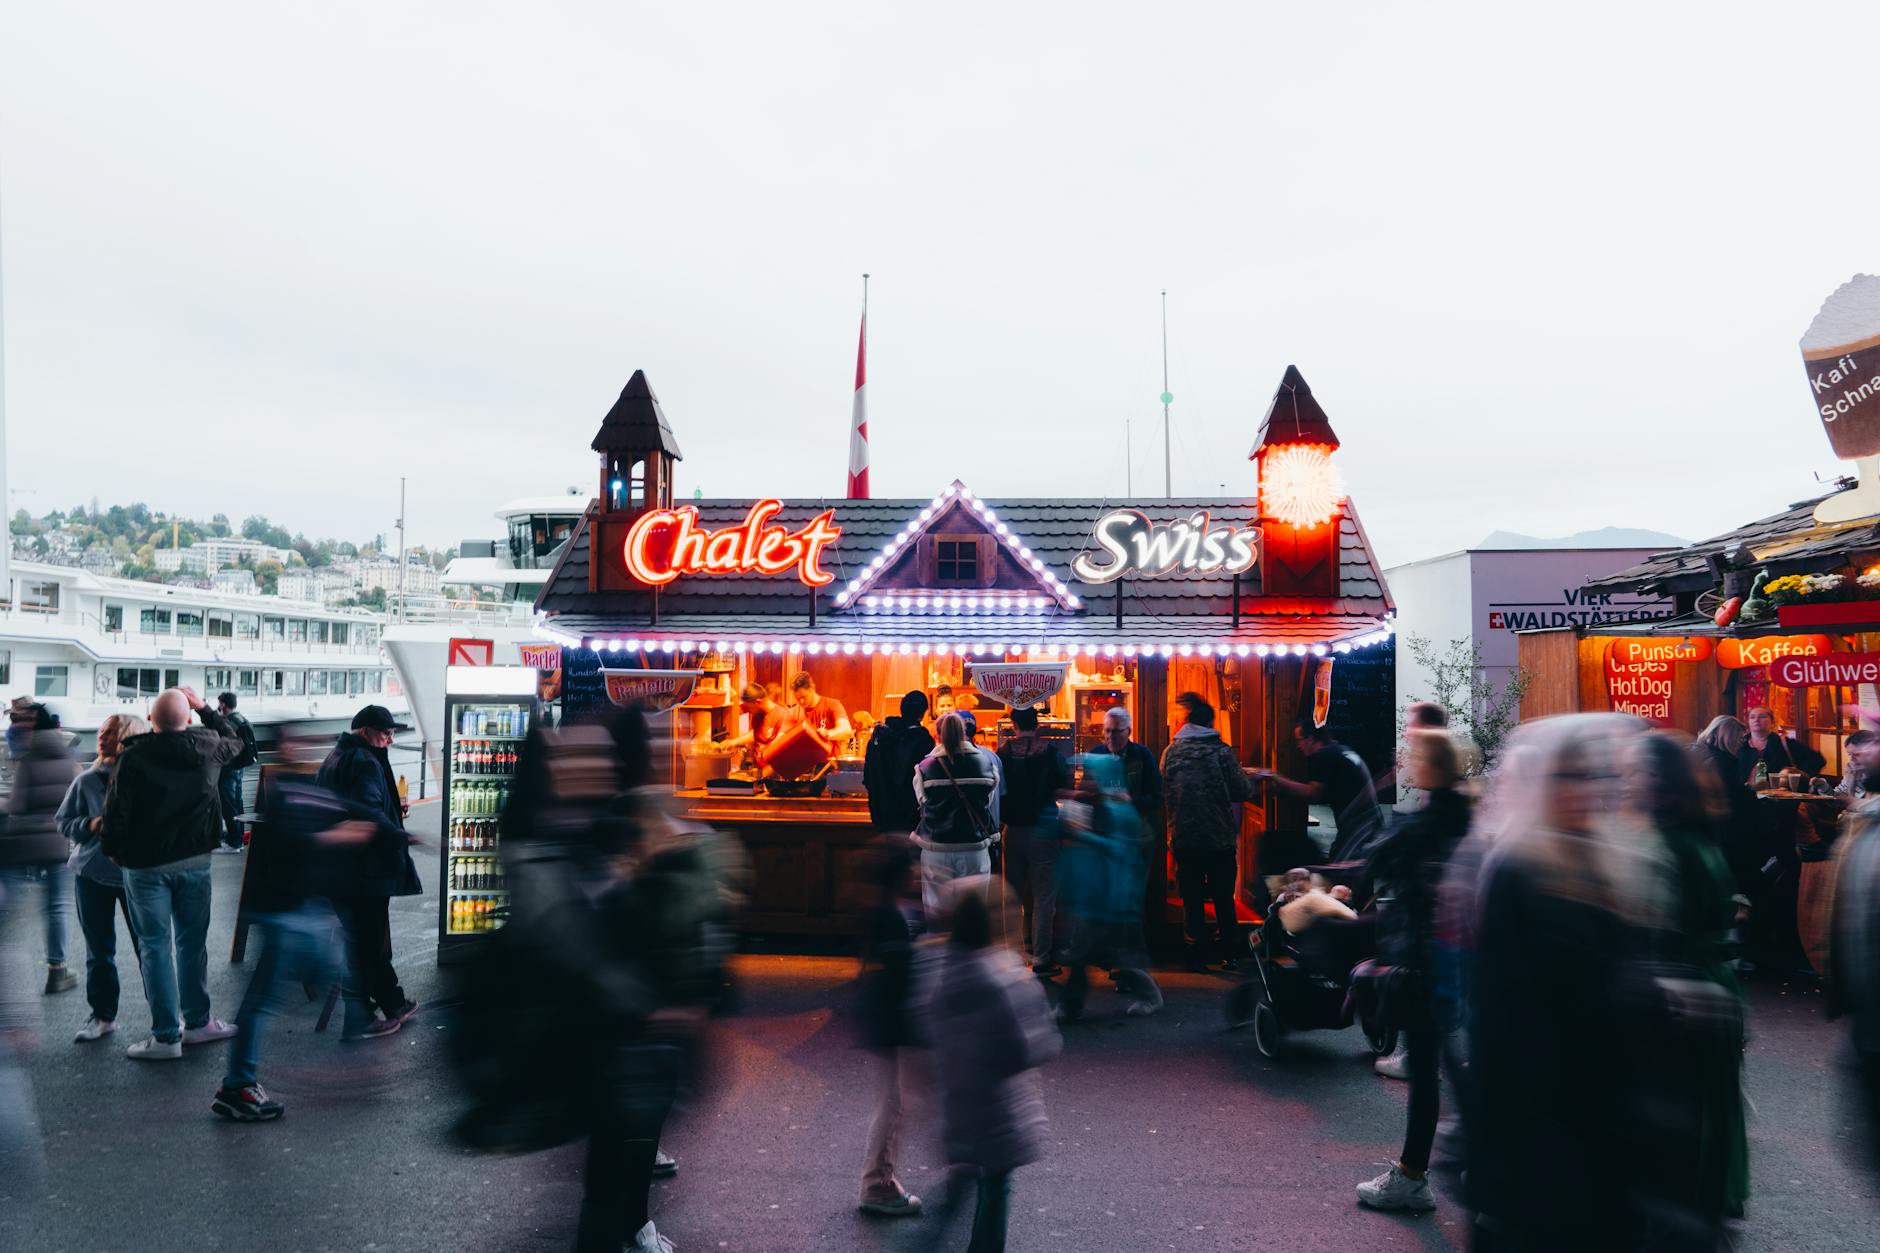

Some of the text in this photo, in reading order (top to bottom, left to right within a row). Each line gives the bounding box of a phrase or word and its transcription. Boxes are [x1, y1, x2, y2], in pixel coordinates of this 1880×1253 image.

[1811, 354, 1857, 394] Kafi
[624, 499, 841, 587] Chalet
[1072, 510, 1262, 583] Swiss
[1564, 589, 1613, 606] VIER
[1629, 643, 1697, 661] Punsch
[1739, 642, 1817, 665] Kaffee
[981, 670, 1057, 693] Älplermagronen
[1783, 659, 1880, 684] Glühwe
[1610, 676, 1672, 699] Hot Dog
[1614, 699, 1669, 718] Mineral
